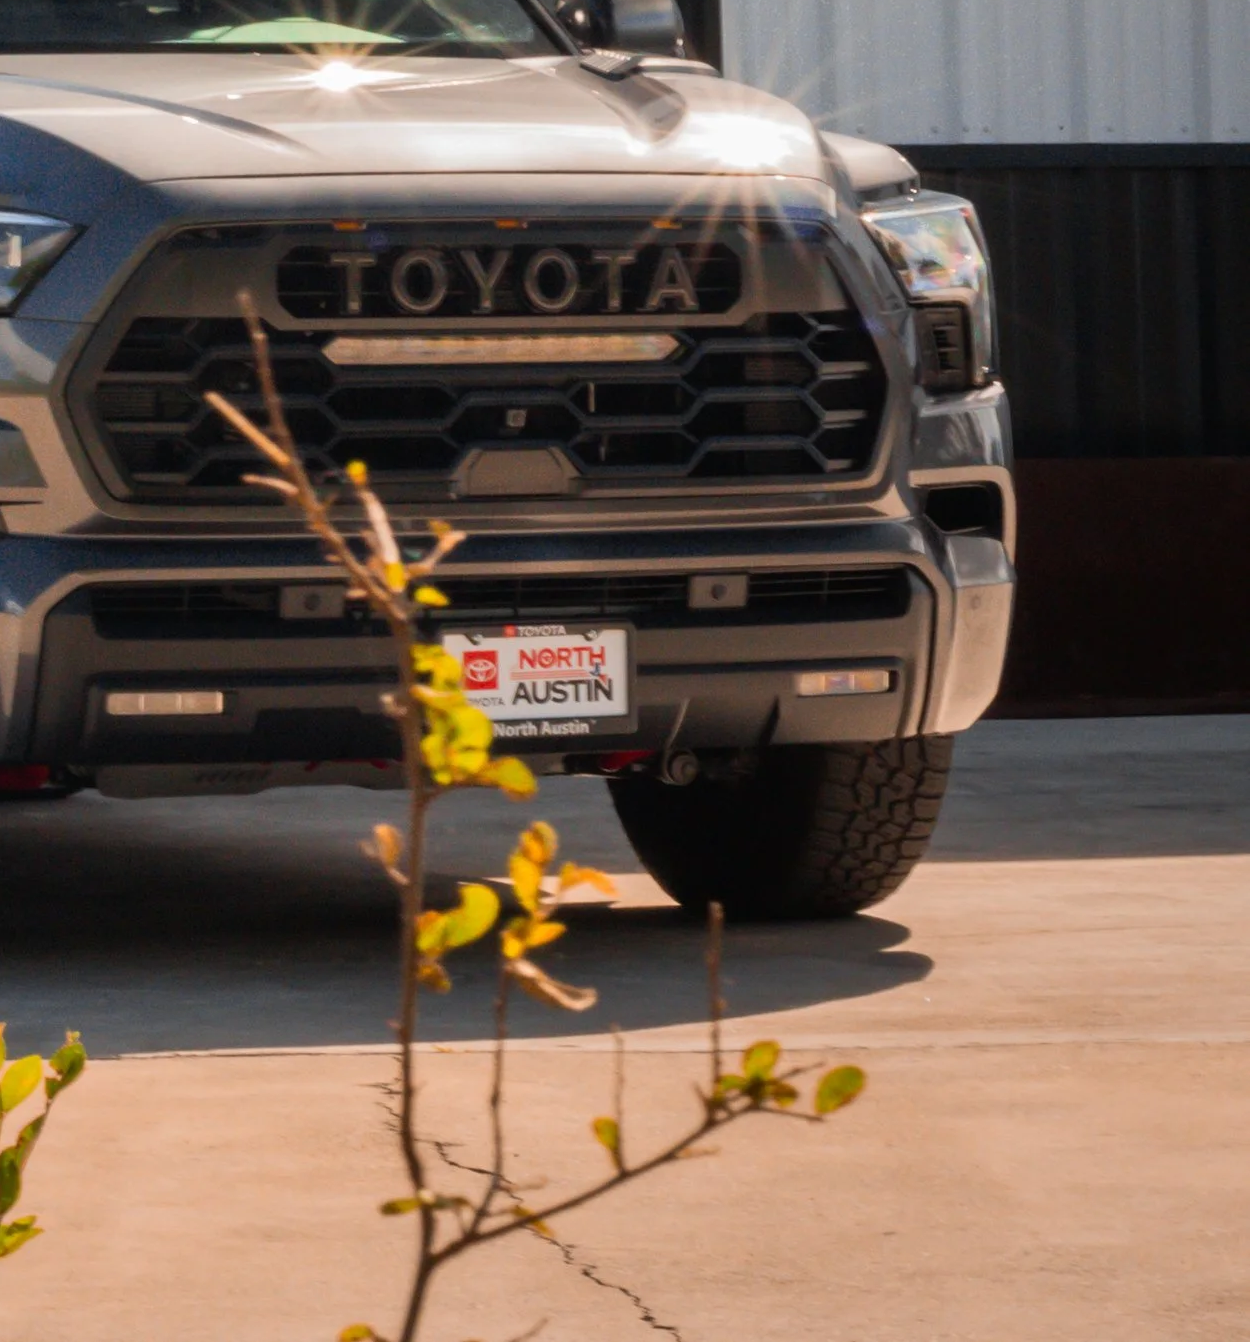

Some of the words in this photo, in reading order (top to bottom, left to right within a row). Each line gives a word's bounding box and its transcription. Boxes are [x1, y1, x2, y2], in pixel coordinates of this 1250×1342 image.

[330, 246, 700, 315] TOYOTA
[517, 624, 567, 637] TOYOTA
[518, 645, 606, 670] NORTH
[512, 677, 613, 705] AUSTIN
[493, 722, 538, 737] North
[541, 719, 590, 735] Austin
